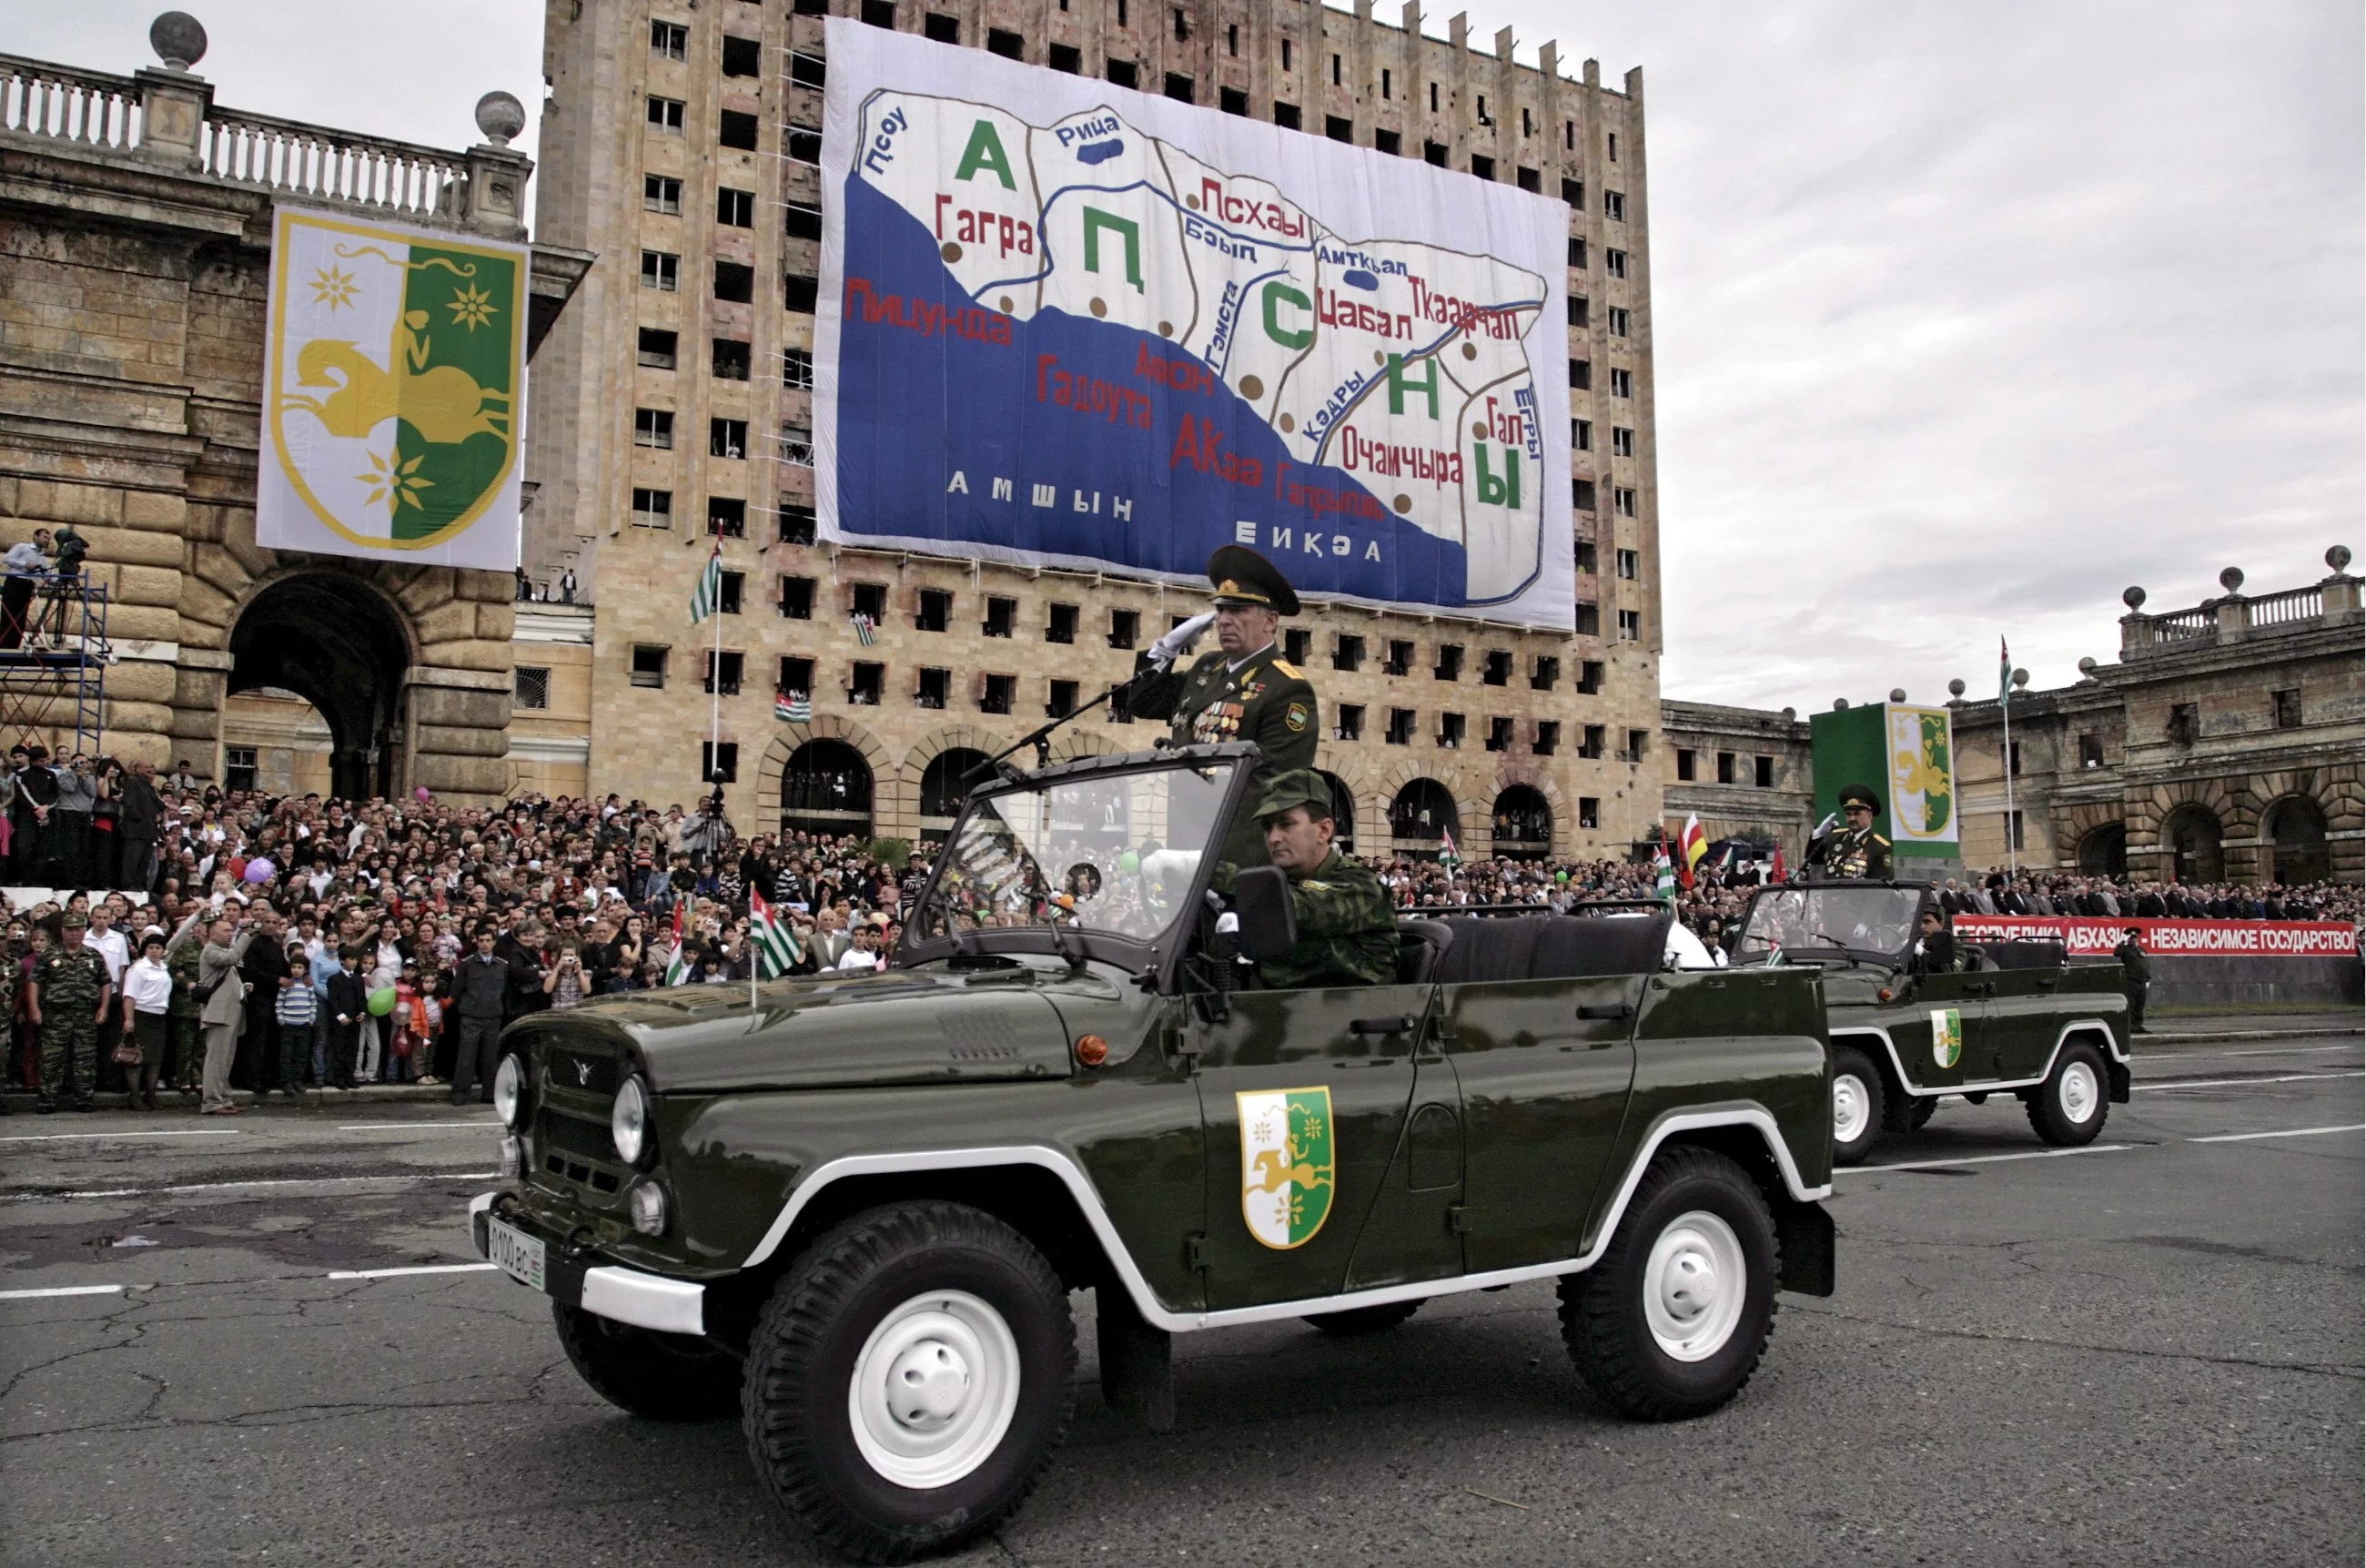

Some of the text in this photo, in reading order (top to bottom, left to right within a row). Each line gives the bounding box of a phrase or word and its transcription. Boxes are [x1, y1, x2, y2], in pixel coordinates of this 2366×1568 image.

[935, 193, 1033, 258] Гагра
[844, 278, 1012, 345] Пицунда
[1486, 396, 1522, 445] Гал
[1514, 389, 1540, 460] Егры
[1342, 425, 1463, 491] Очамчыра
[947, 470, 1132, 521] АМШЫН
[2067, 926, 2129, 948] АБХАЗИ
[2150, 928, 2258, 949] НЕЗАВИСИМОЕ
[2260, 929, 2355, 953] ГОСУДАРСТВО!
